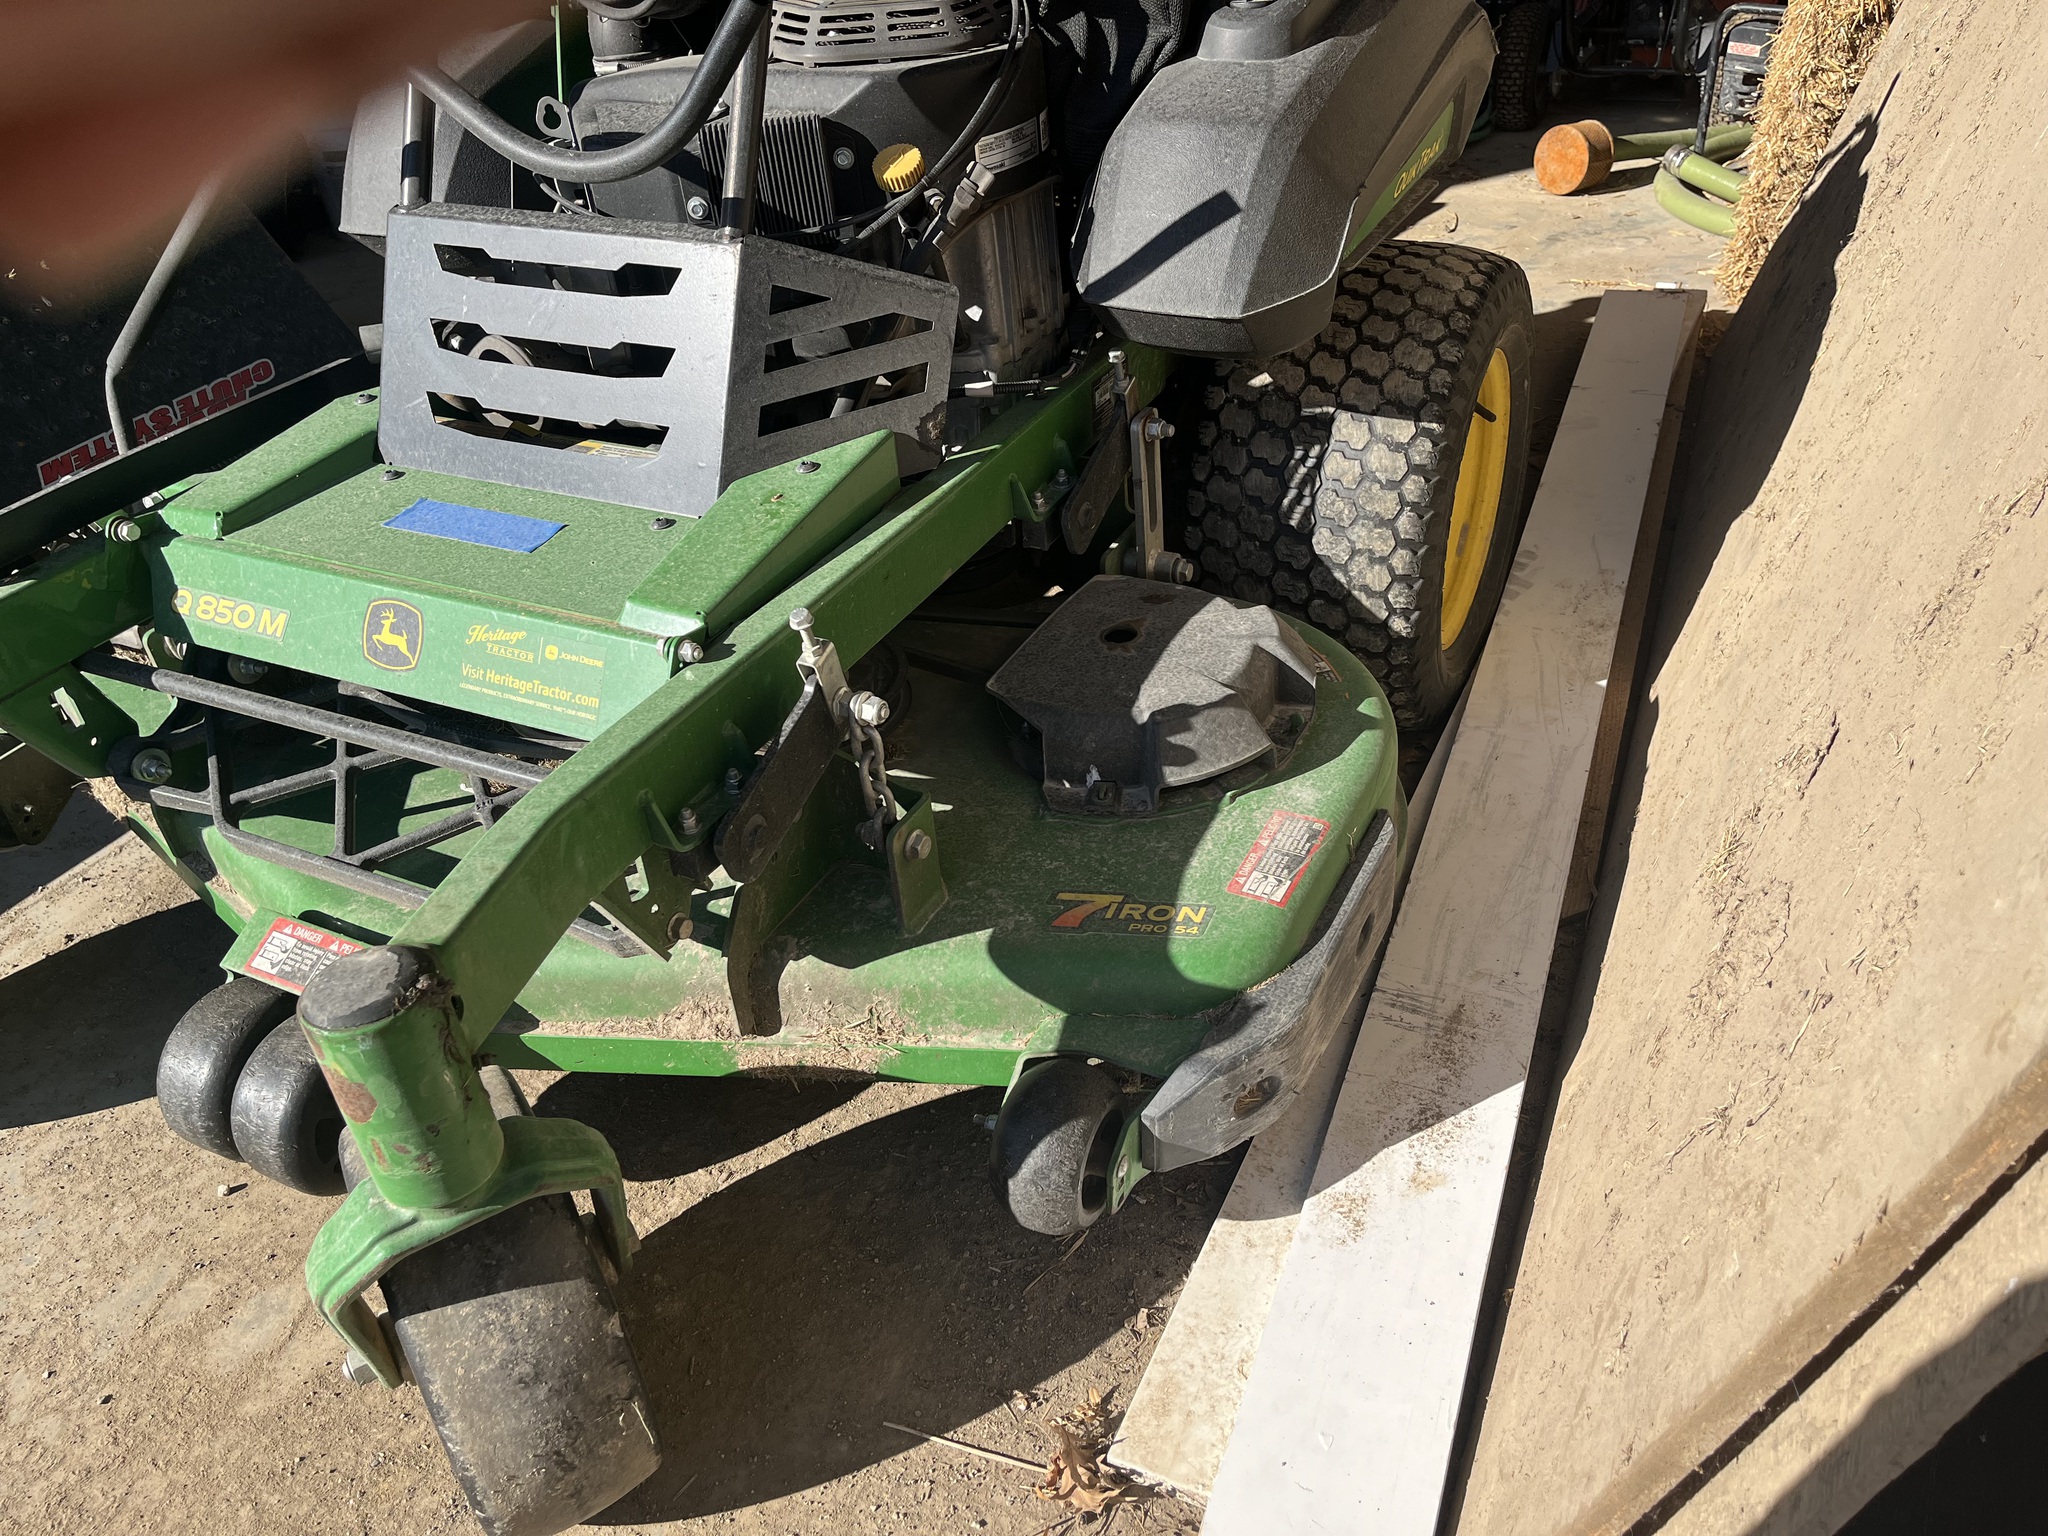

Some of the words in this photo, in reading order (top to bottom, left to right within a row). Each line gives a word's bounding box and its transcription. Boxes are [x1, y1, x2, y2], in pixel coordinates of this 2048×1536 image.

[178, 359, 274, 415] CHUTE
[39, 406, 174, 486] SYTEM
[465, 624, 528, 645] Heritage
[486, 642, 534, 662] TRACTOR
[559, 651, 579, 662] JOHN
[579, 655, 604, 668] DEERE
[462, 662, 484, 681] Visit
[485, 669, 600, 709] HeritageTractor.com
[1239, 852, 1259, 877] DANGER
[293, 925, 324, 944] DANGER
[1128, 923, 1168, 934] PRO
[1173, 925, 1199, 935] 54
